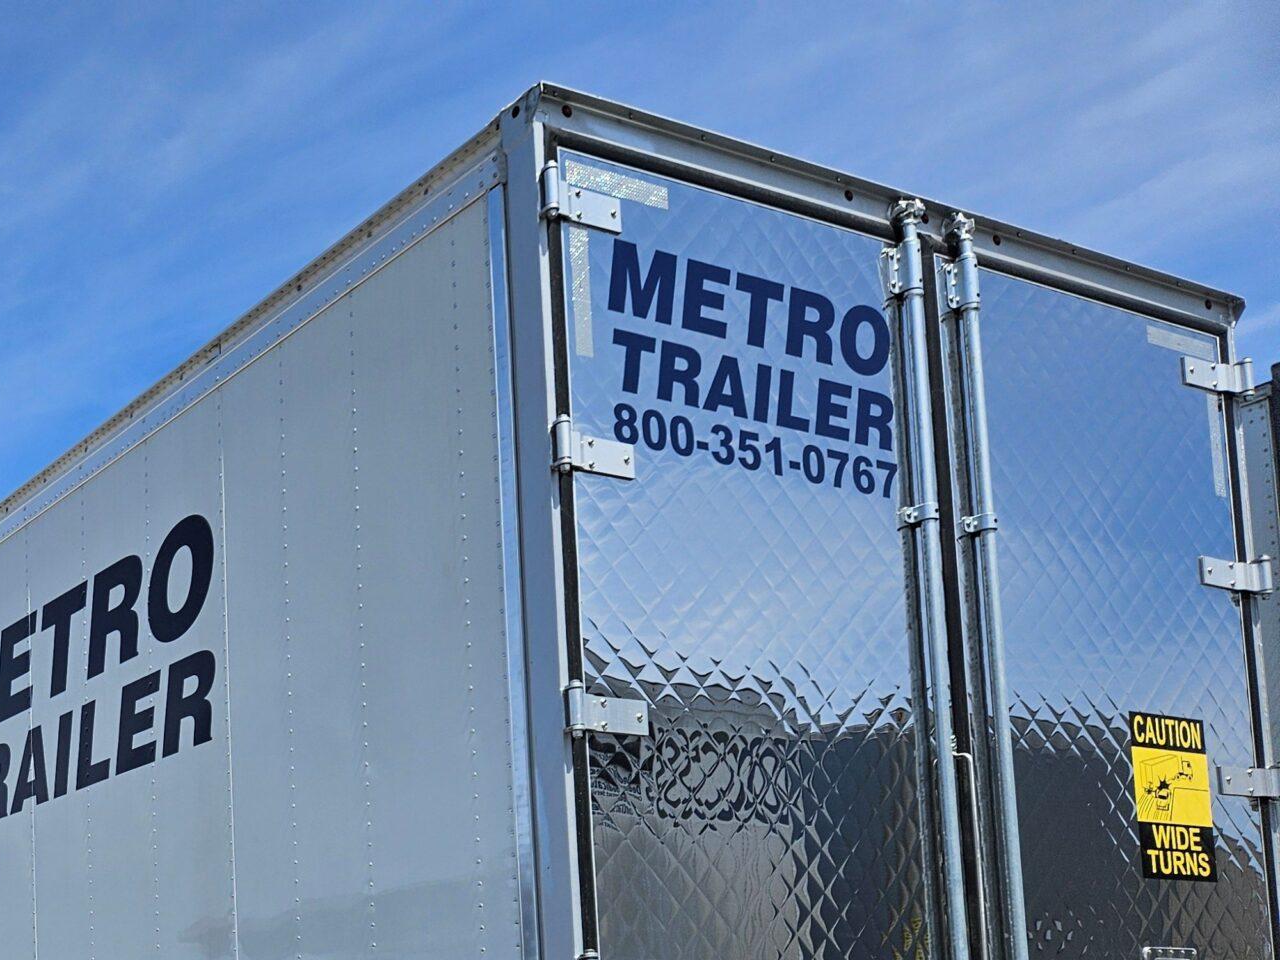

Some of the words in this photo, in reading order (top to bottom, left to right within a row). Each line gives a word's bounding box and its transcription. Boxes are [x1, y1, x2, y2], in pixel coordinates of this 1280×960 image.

[607, 238, 891, 377] METRO
[612, 328, 895, 451] TRAILER
[613, 403, 898, 499] 800-351-0767
[1133, 714, 1202, 750] CAUTION
[1146, 849, 1211, 878] TURNS
[1152, 824, 1202, 852] WIDE
